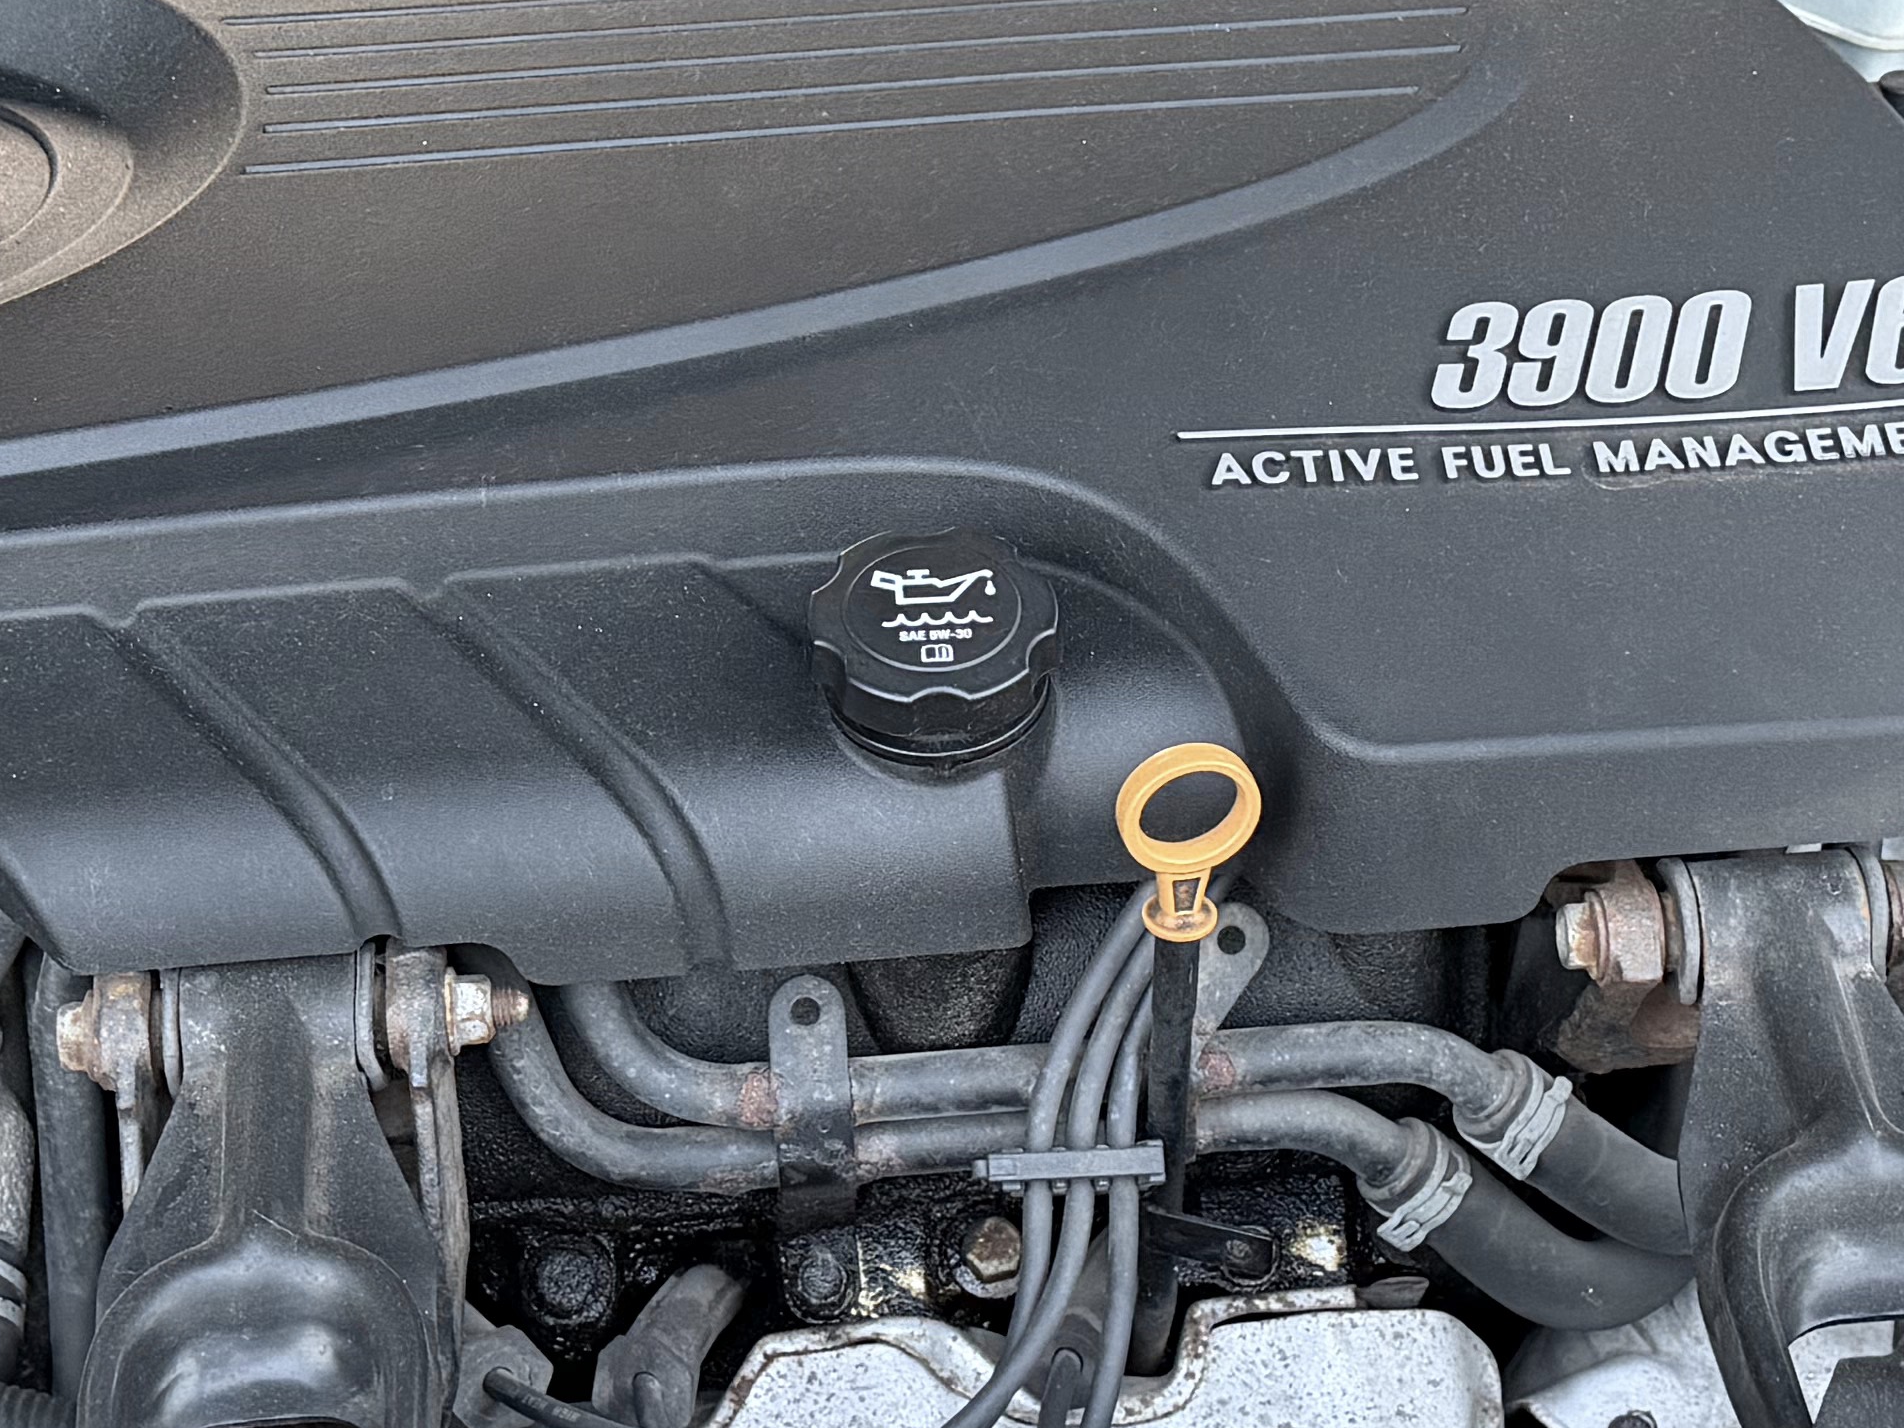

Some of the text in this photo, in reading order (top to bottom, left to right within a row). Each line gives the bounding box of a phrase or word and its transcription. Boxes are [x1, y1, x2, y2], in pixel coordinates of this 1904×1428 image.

[1431, 289, 1753, 410] 3900
[1211, 447, 1418, 487] ACTIVE
[1445, 442, 1571, 481] FUEL
[899, 628, 973, 642] SAE 5W-30
